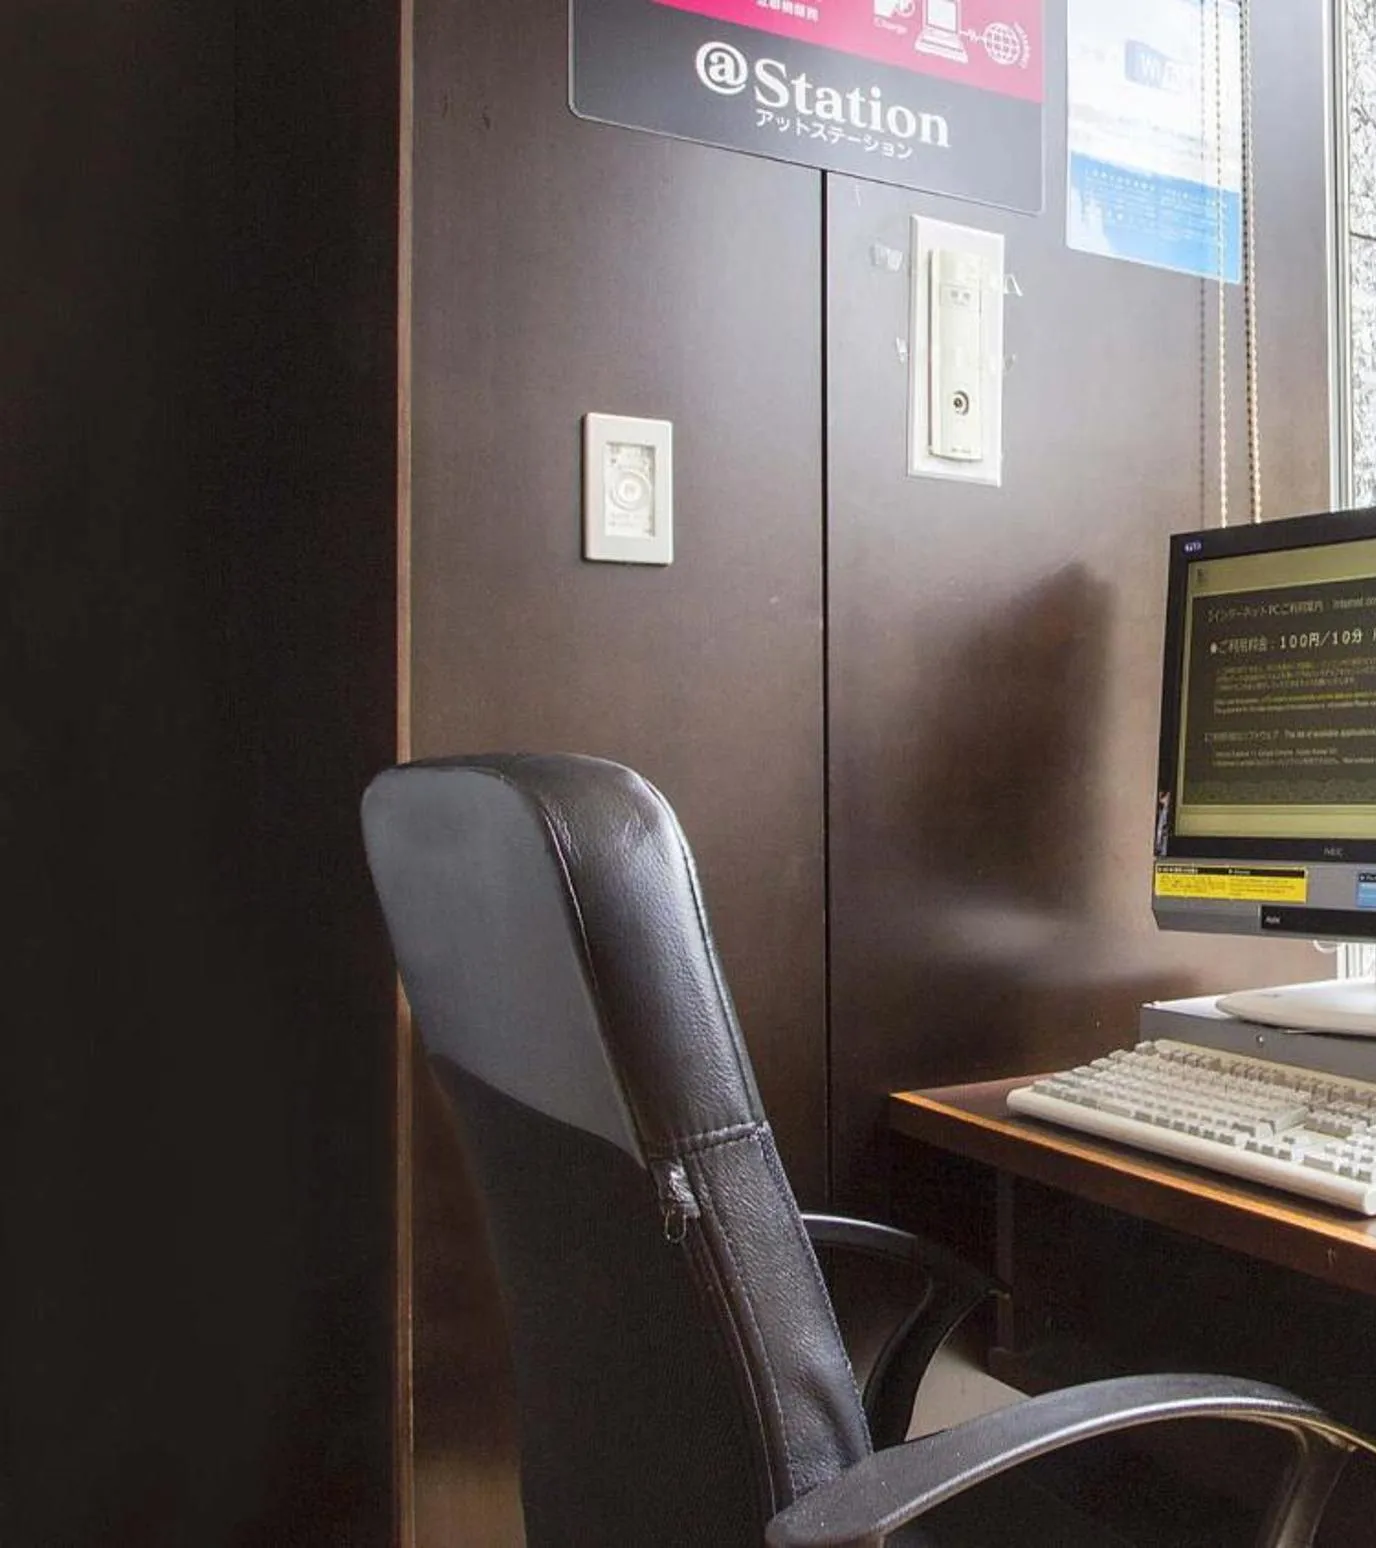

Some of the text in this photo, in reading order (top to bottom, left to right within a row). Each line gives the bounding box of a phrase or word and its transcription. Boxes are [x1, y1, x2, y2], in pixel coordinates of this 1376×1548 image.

[695, 41, 951, 148] @Station
[755, 109, 913, 158] アットステーション
